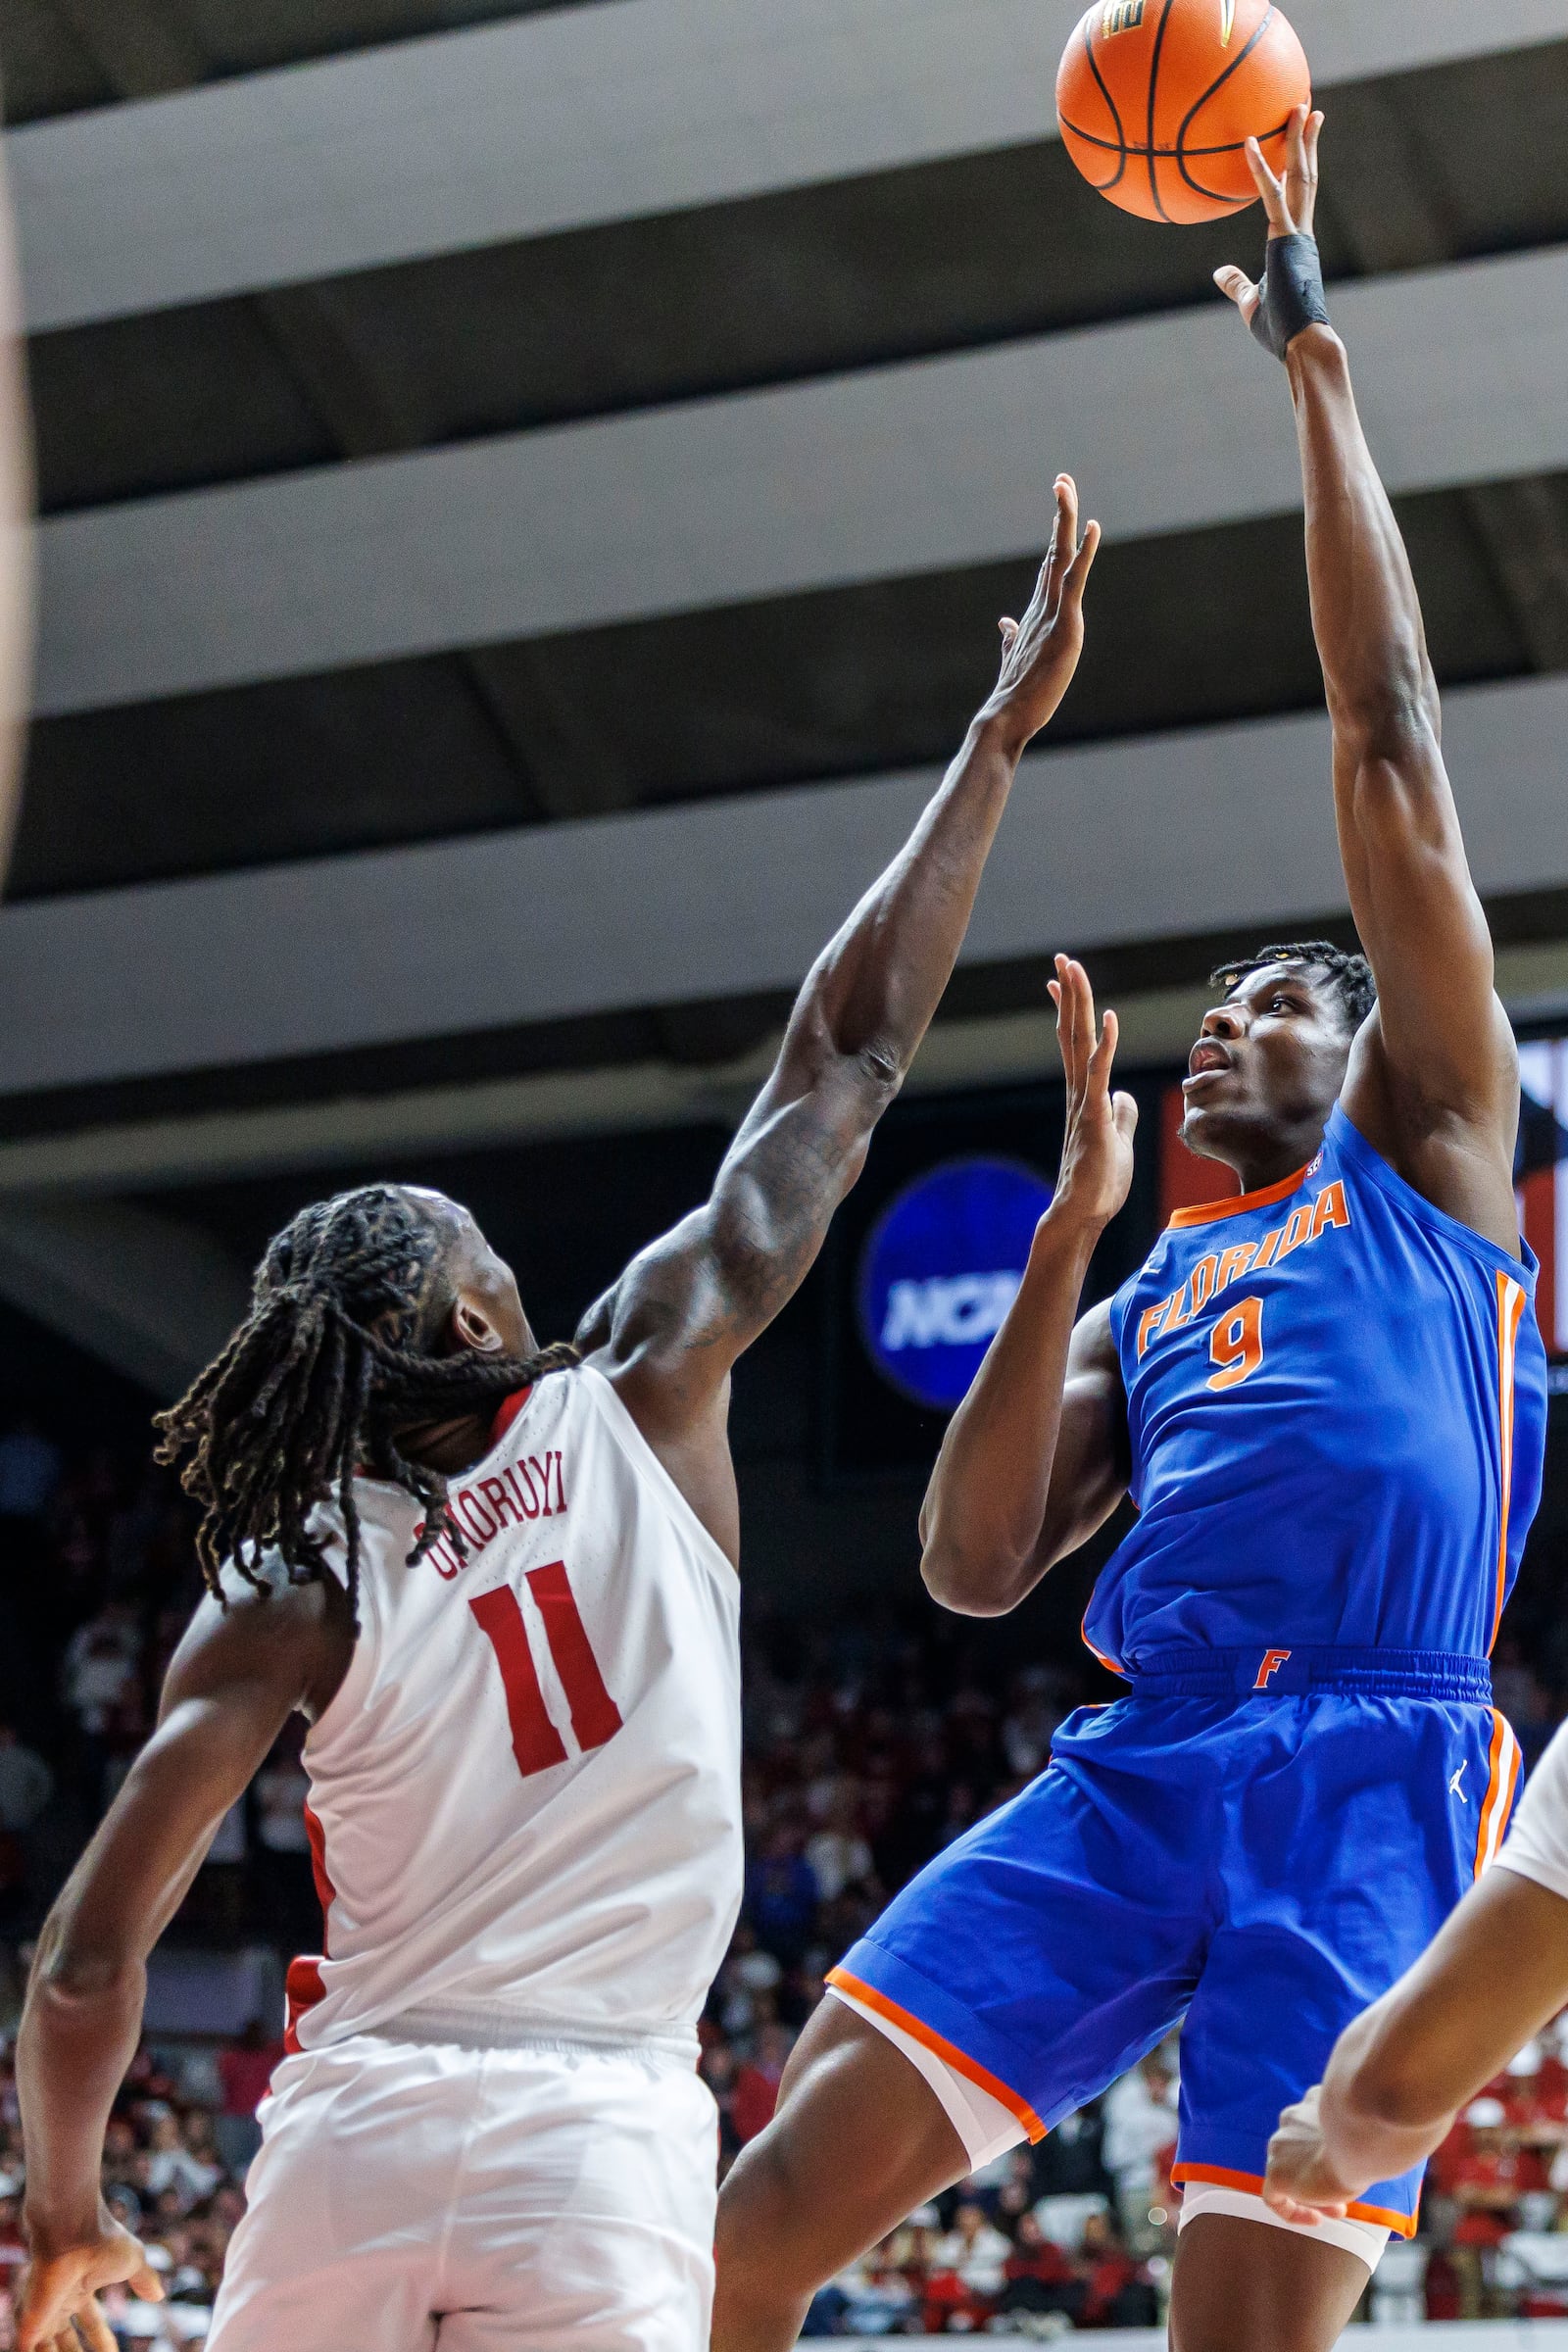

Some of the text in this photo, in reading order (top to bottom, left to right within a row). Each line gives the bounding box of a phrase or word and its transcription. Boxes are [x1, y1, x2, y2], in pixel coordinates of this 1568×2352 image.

[1138, 1179, 1350, 1365] FLORIDA
[1205, 1295, 1264, 1393] 9
[467, 1559, 624, 1778] 11
[1252, 1648, 1293, 1690] F
